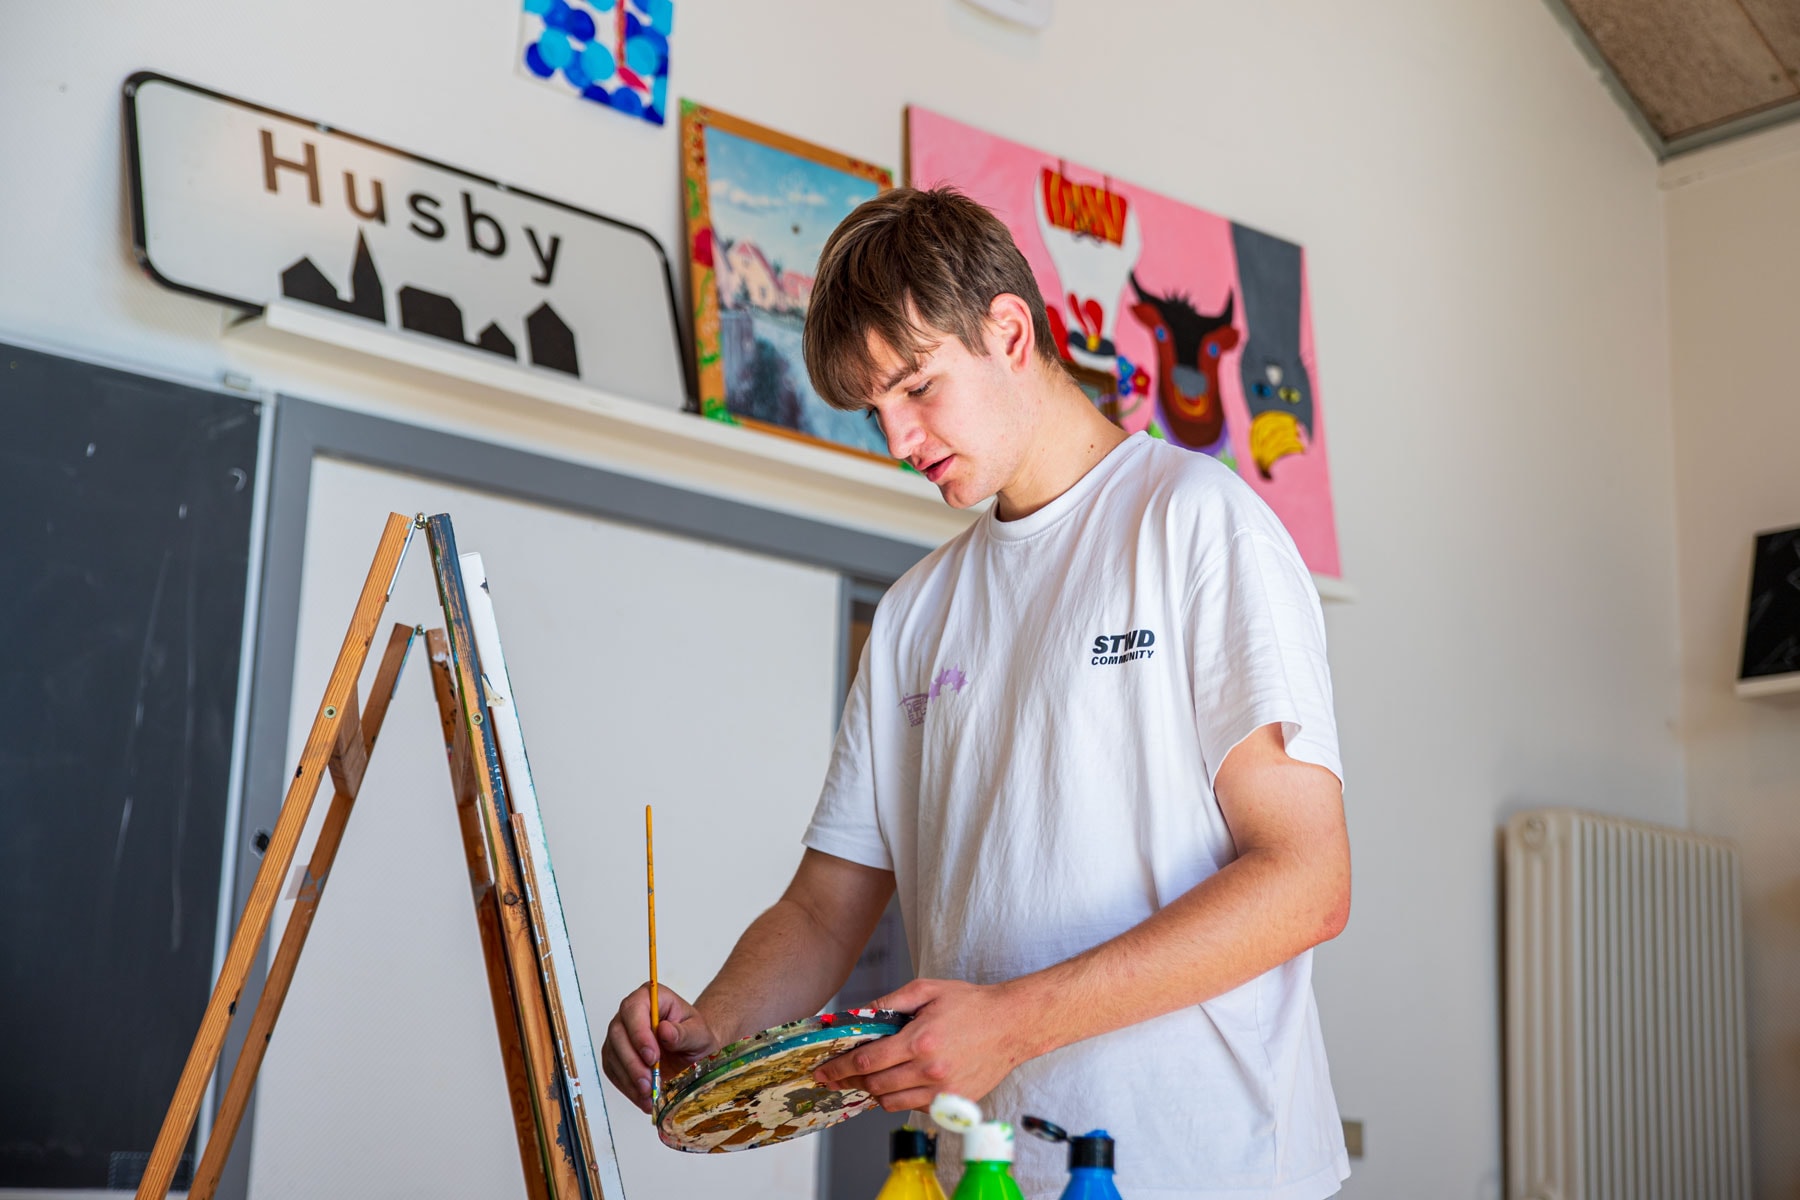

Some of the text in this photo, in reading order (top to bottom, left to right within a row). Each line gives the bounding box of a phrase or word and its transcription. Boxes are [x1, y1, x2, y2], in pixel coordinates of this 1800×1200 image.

[260, 129, 561, 286] Husby
[1092, 629, 1155, 654] STWD
[1091, 650, 1154, 666] COMMUNITY
